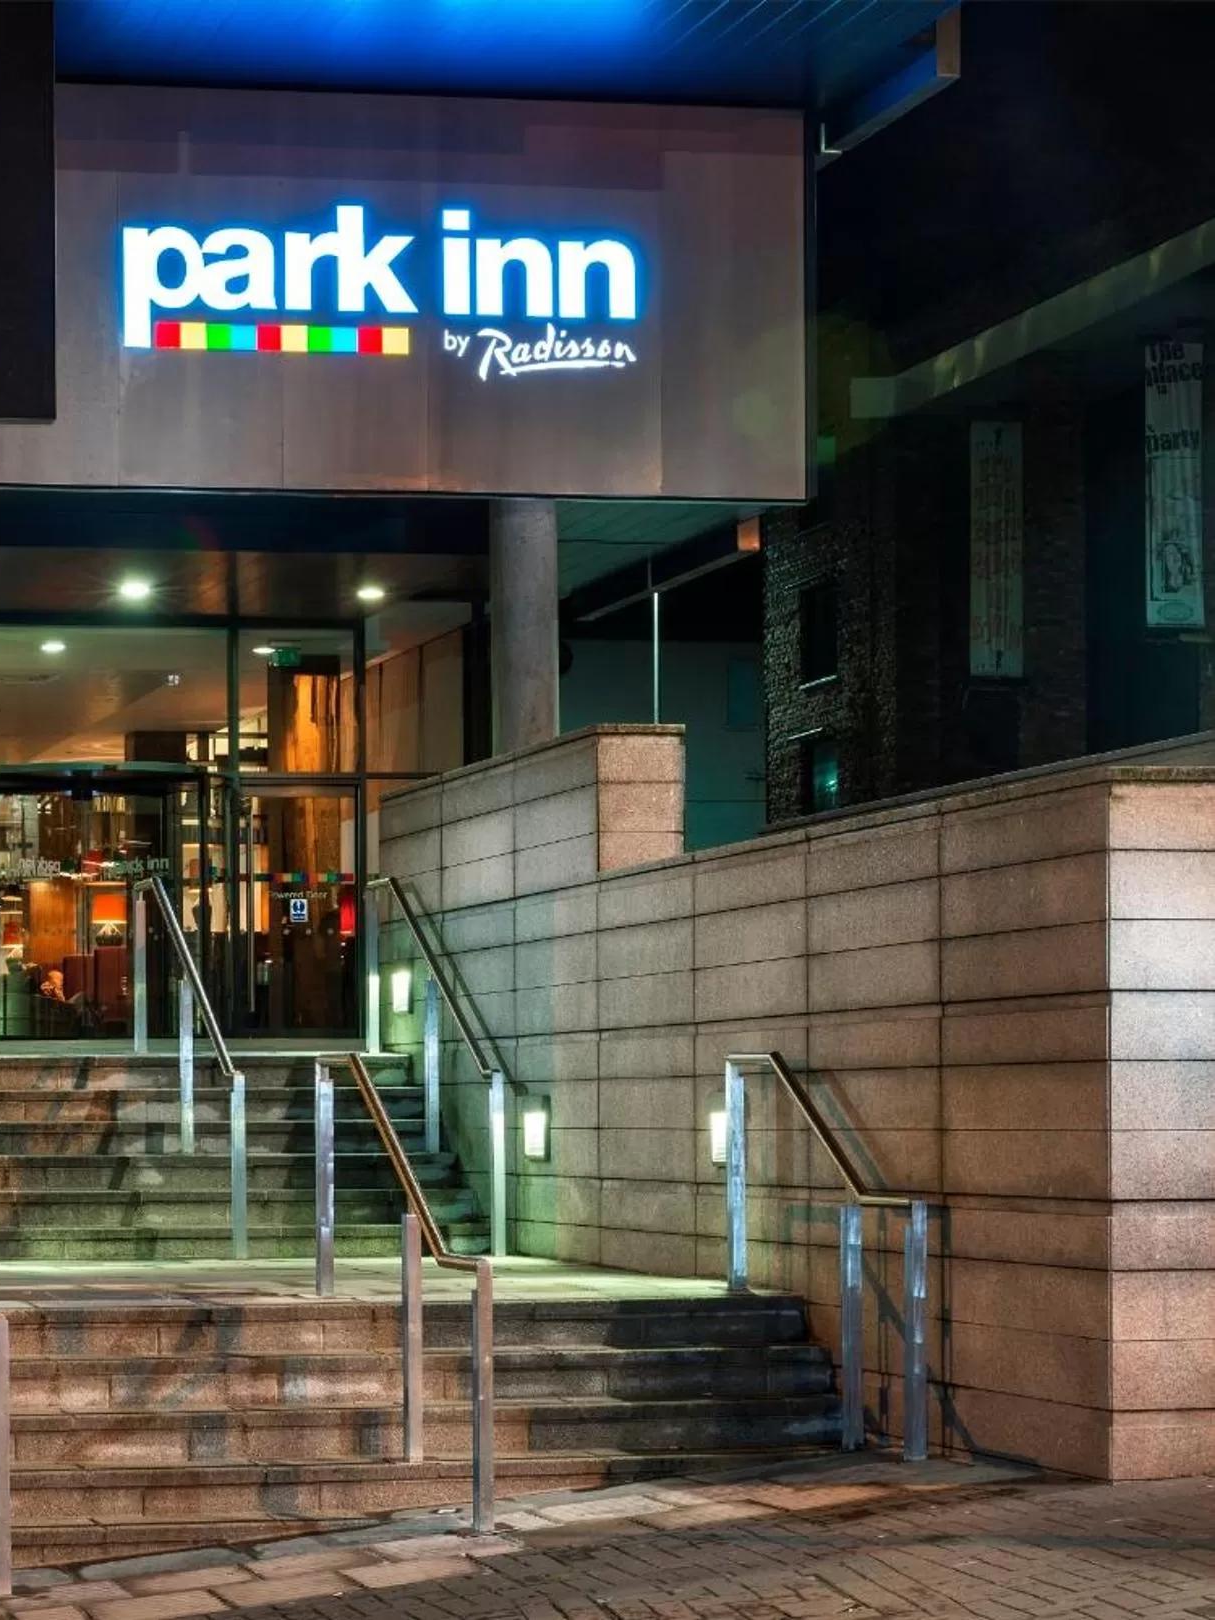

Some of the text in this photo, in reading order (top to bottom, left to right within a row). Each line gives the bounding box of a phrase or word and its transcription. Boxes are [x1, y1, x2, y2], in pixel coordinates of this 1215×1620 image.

[123, 205, 635, 347] park inn
[444, 322, 637, 381] by Radisson
